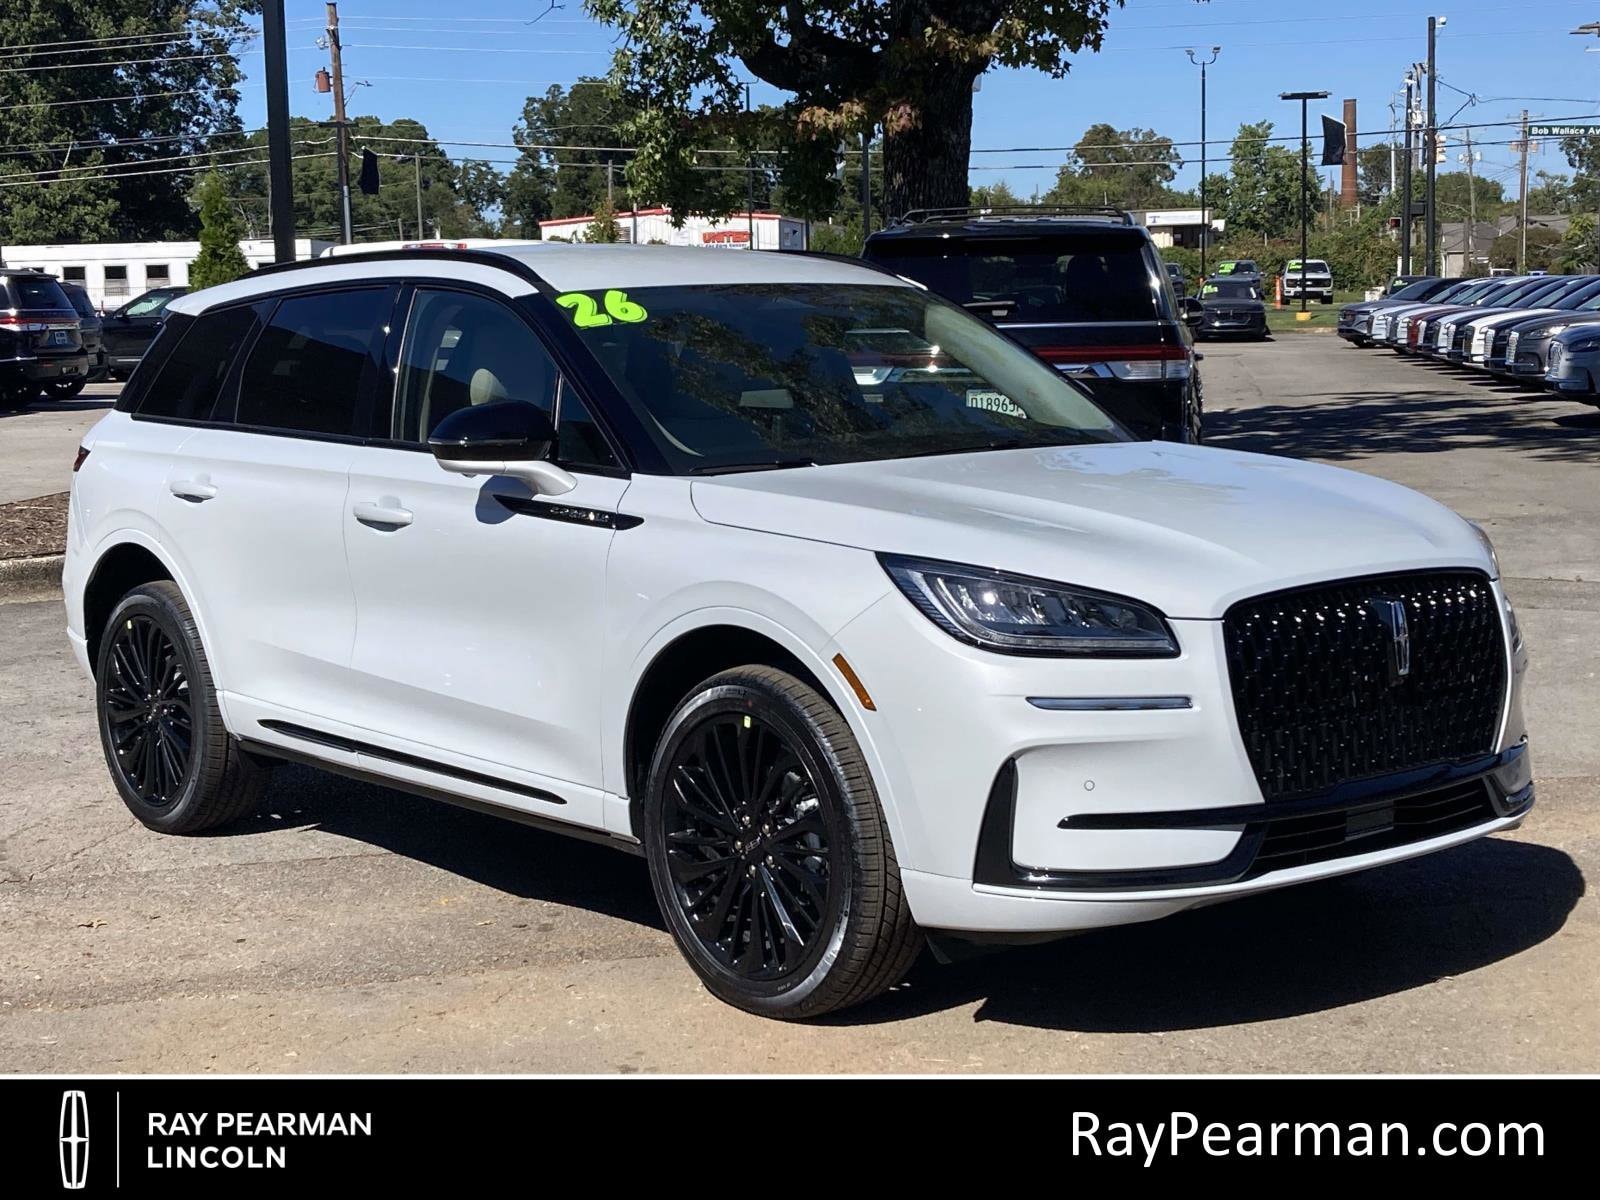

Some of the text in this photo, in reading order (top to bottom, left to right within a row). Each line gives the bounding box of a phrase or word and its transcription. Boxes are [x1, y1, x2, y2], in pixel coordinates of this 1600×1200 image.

[1531, 126, 1549, 135] Bob
[1551, 126, 1585, 135] Wallace
[555, 289, 648, 327] 26
